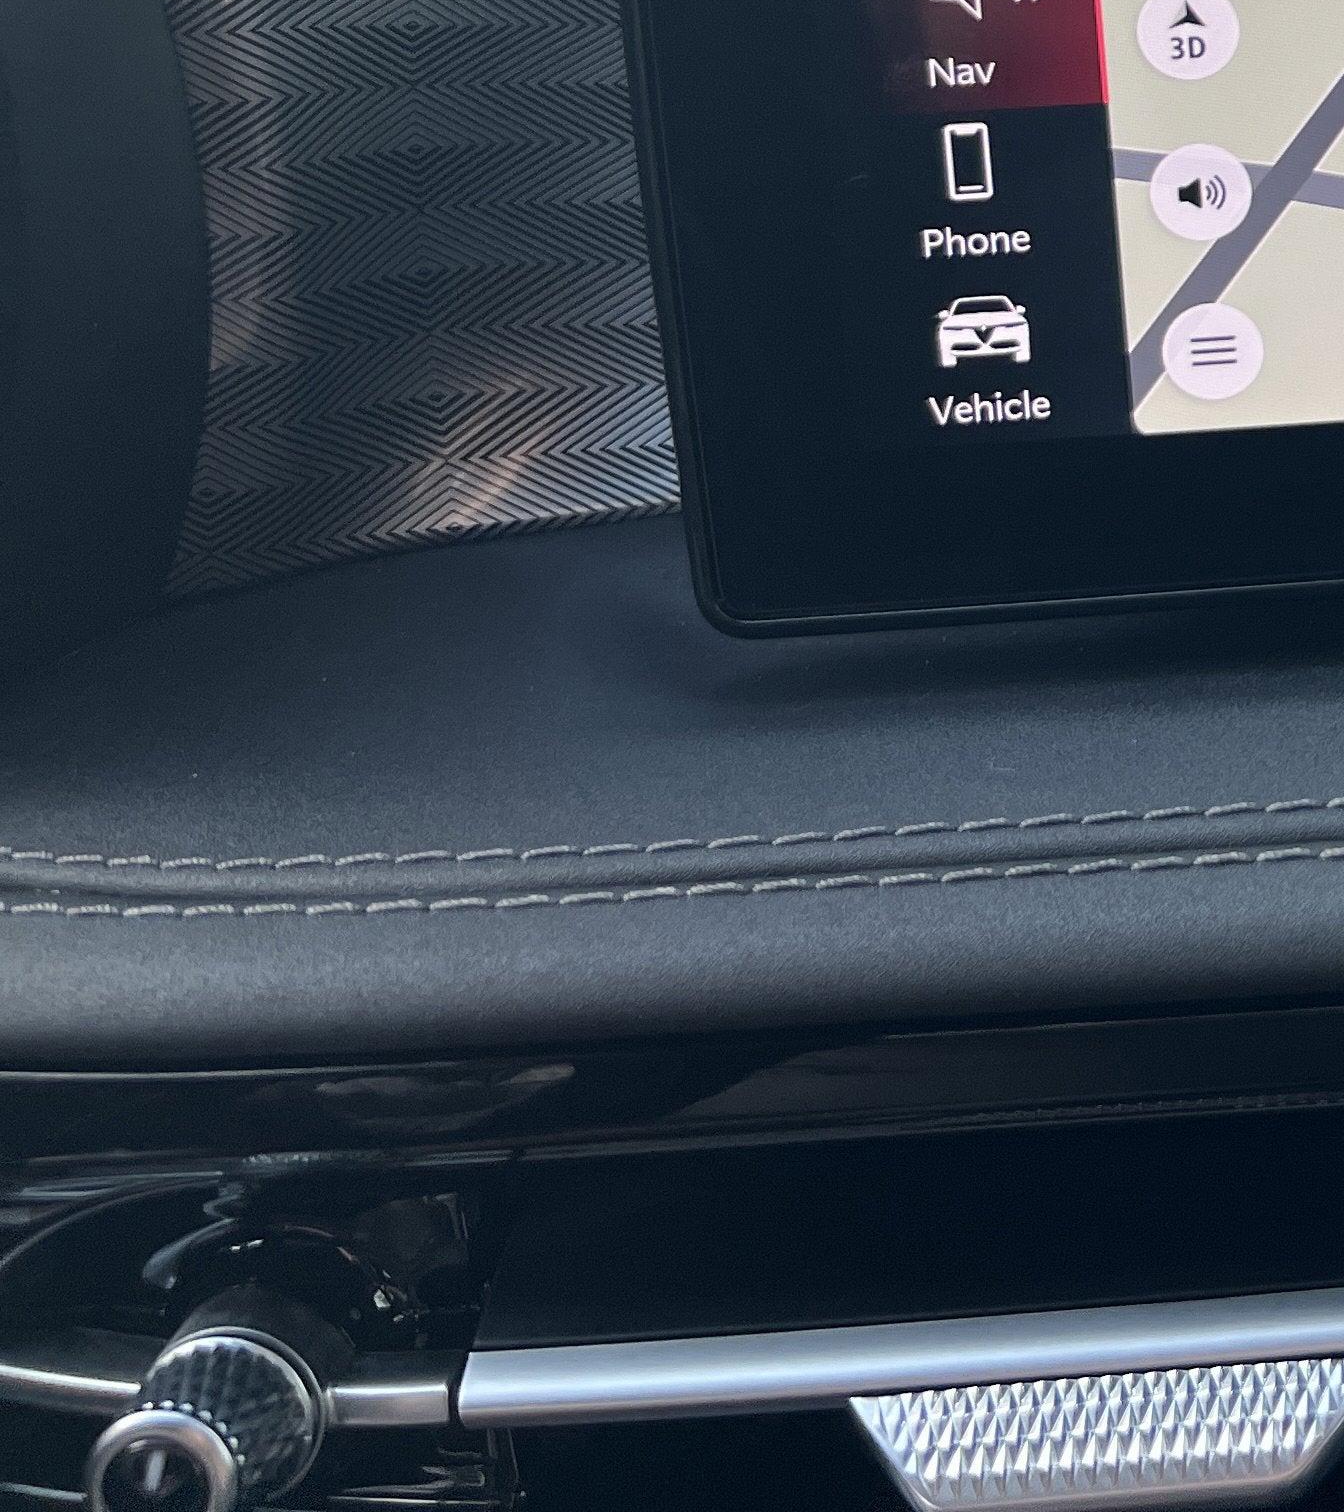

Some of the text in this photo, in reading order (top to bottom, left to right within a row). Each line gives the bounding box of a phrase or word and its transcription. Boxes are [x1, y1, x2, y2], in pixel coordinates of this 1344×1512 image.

[1170, 35, 1207, 60] 3D
[927, 56, 996, 87] Nav
[920, 226, 1031, 259] Phone
[928, 390, 1052, 426] Vehicle
